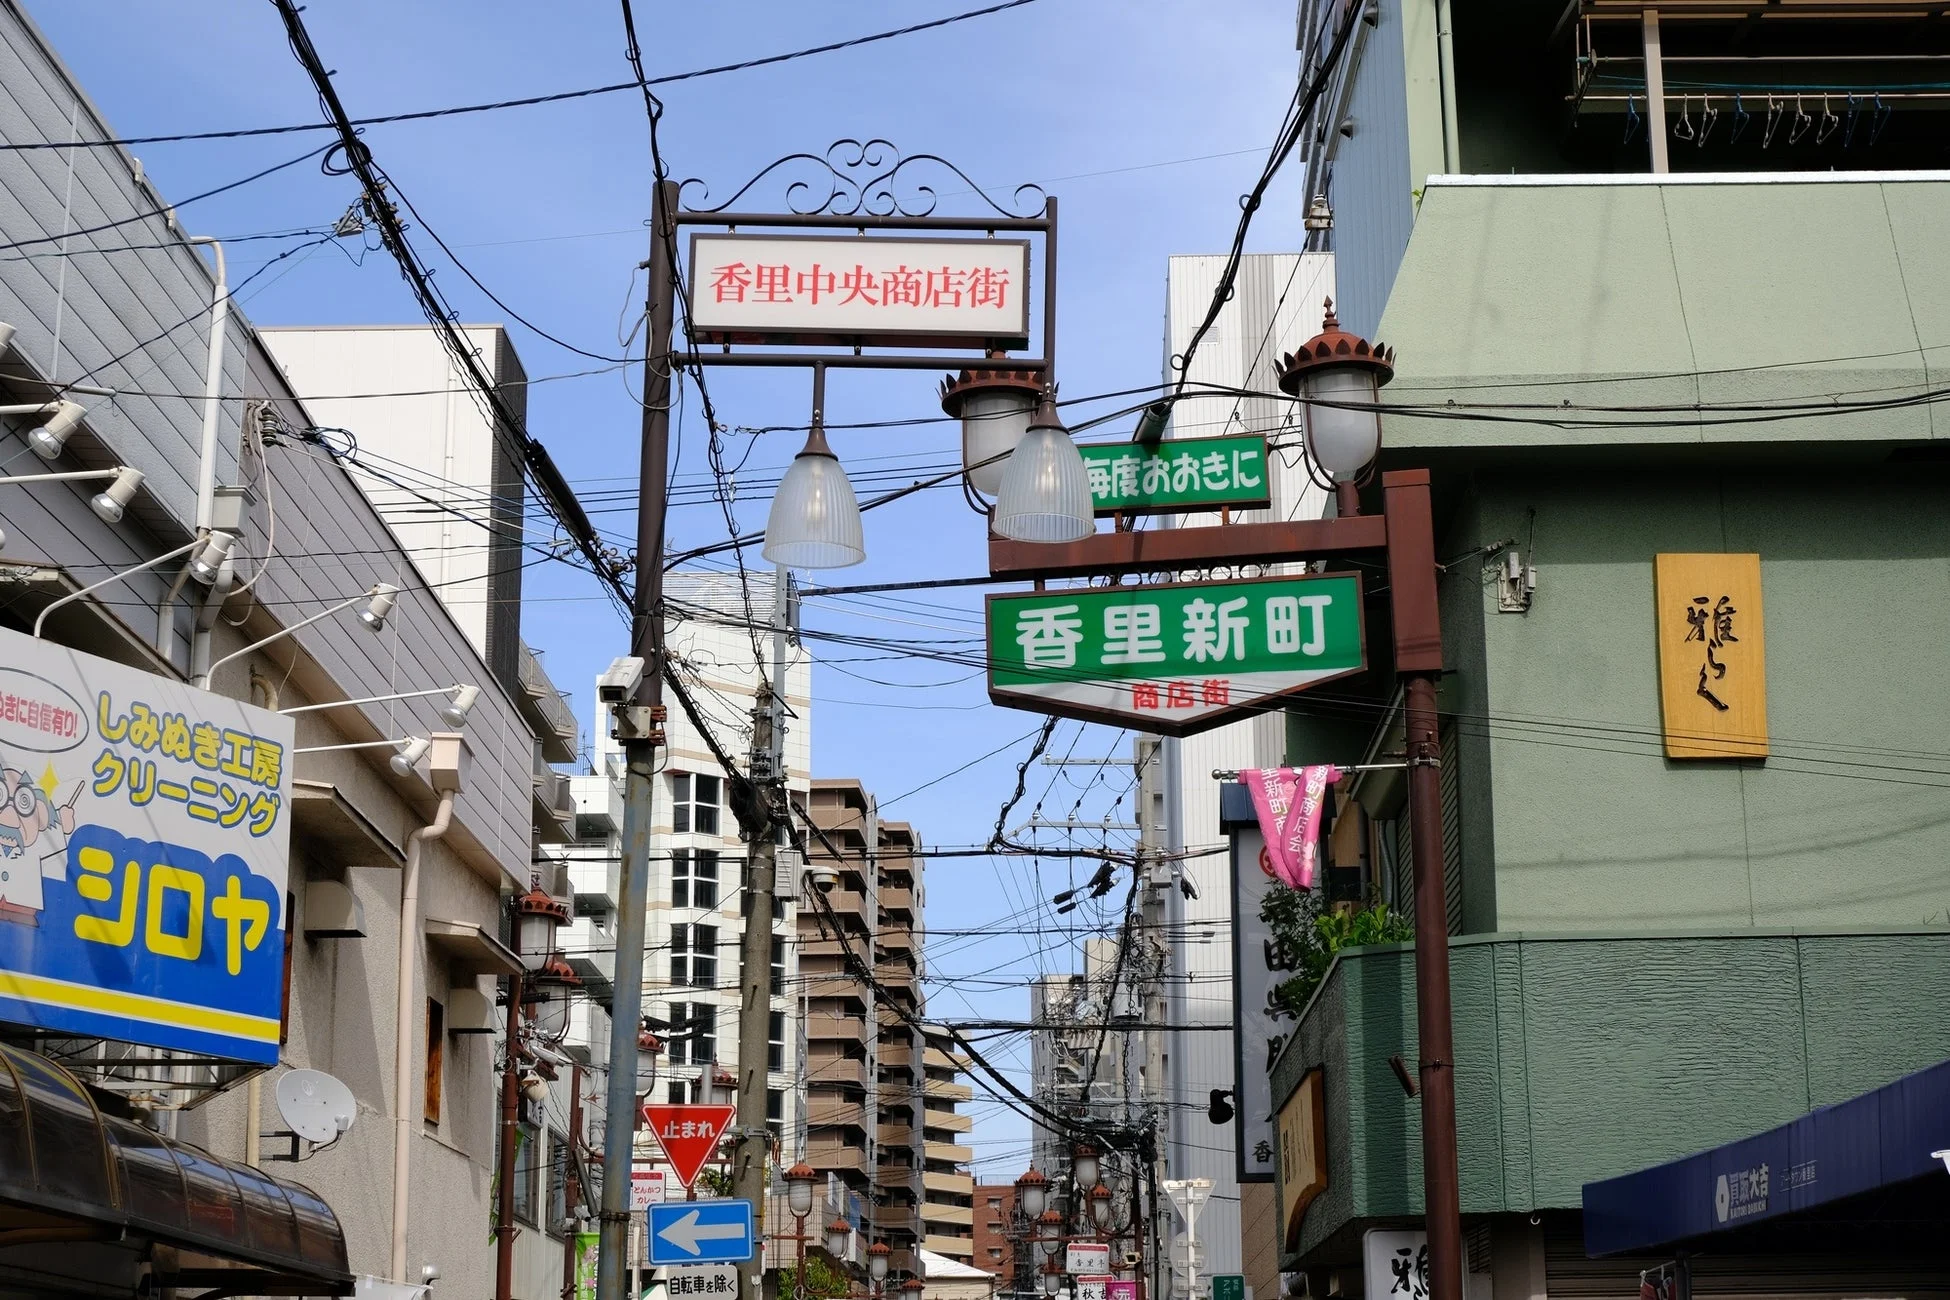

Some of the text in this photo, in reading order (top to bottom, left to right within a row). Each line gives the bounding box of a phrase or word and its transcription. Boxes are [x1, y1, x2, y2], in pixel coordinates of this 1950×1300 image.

[709, 261, 1010, 310] 香里中央商店街
[1083, 449, 1262, 500] 毎度おおきに
[1014, 594, 1333, 671] 香里新町
[1131, 679, 1230, 711] 商店街
[98, 692, 283, 788] しみぬき工房
[94, 750, 281, 837] クリーニング
[74, 845, 270, 977] シロヤ
[661, 1120, 715, 1139] 止まれ
[1252, 1140, 1274, 1163] 香
[636, 1196, 657, 1204] カレー
[670, 1274, 735, 1295] 自転車を除く
